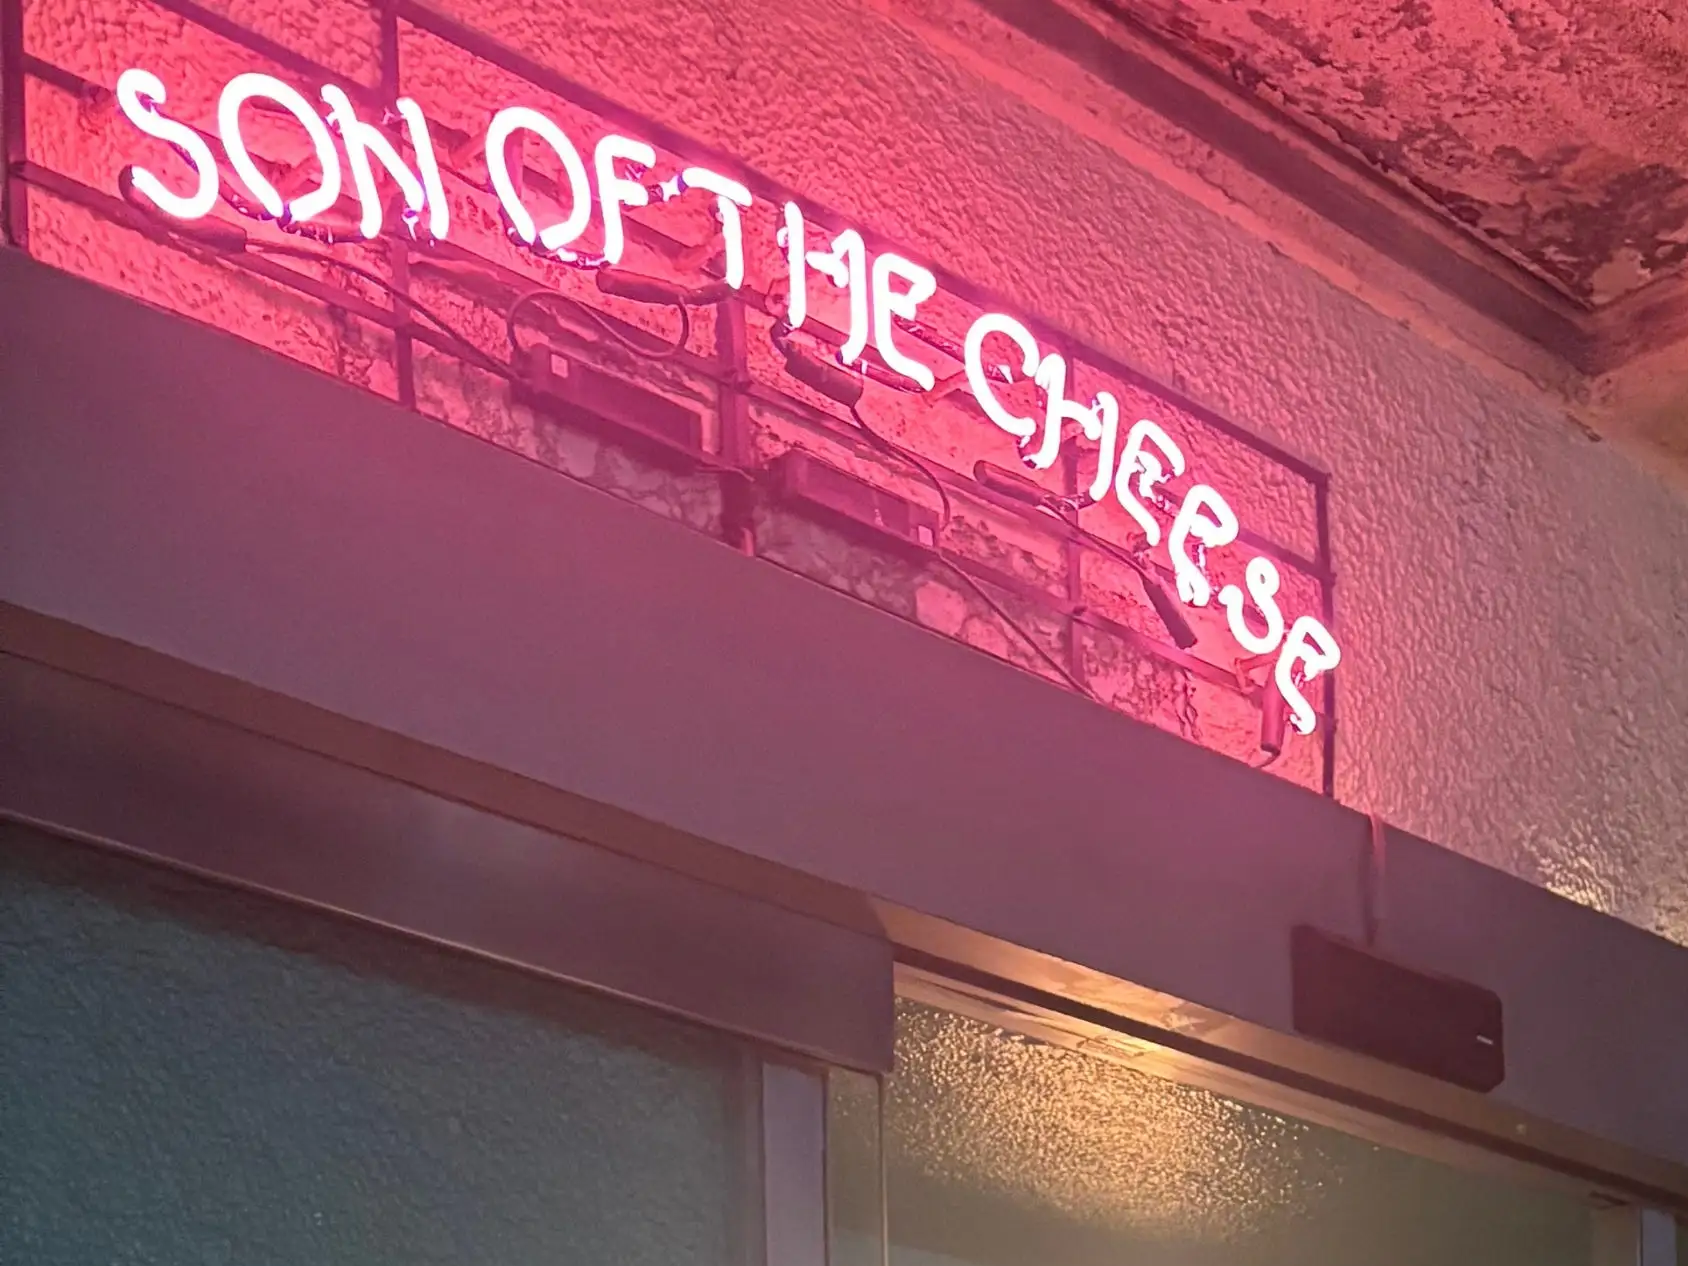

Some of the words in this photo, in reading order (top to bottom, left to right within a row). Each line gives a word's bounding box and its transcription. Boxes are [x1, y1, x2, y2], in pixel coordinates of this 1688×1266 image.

[117, 68, 448, 241] SON
[486, 107, 656, 266] OF
[681, 166, 937, 391] THE
[963, 312, 1341, 735] CHEESE
